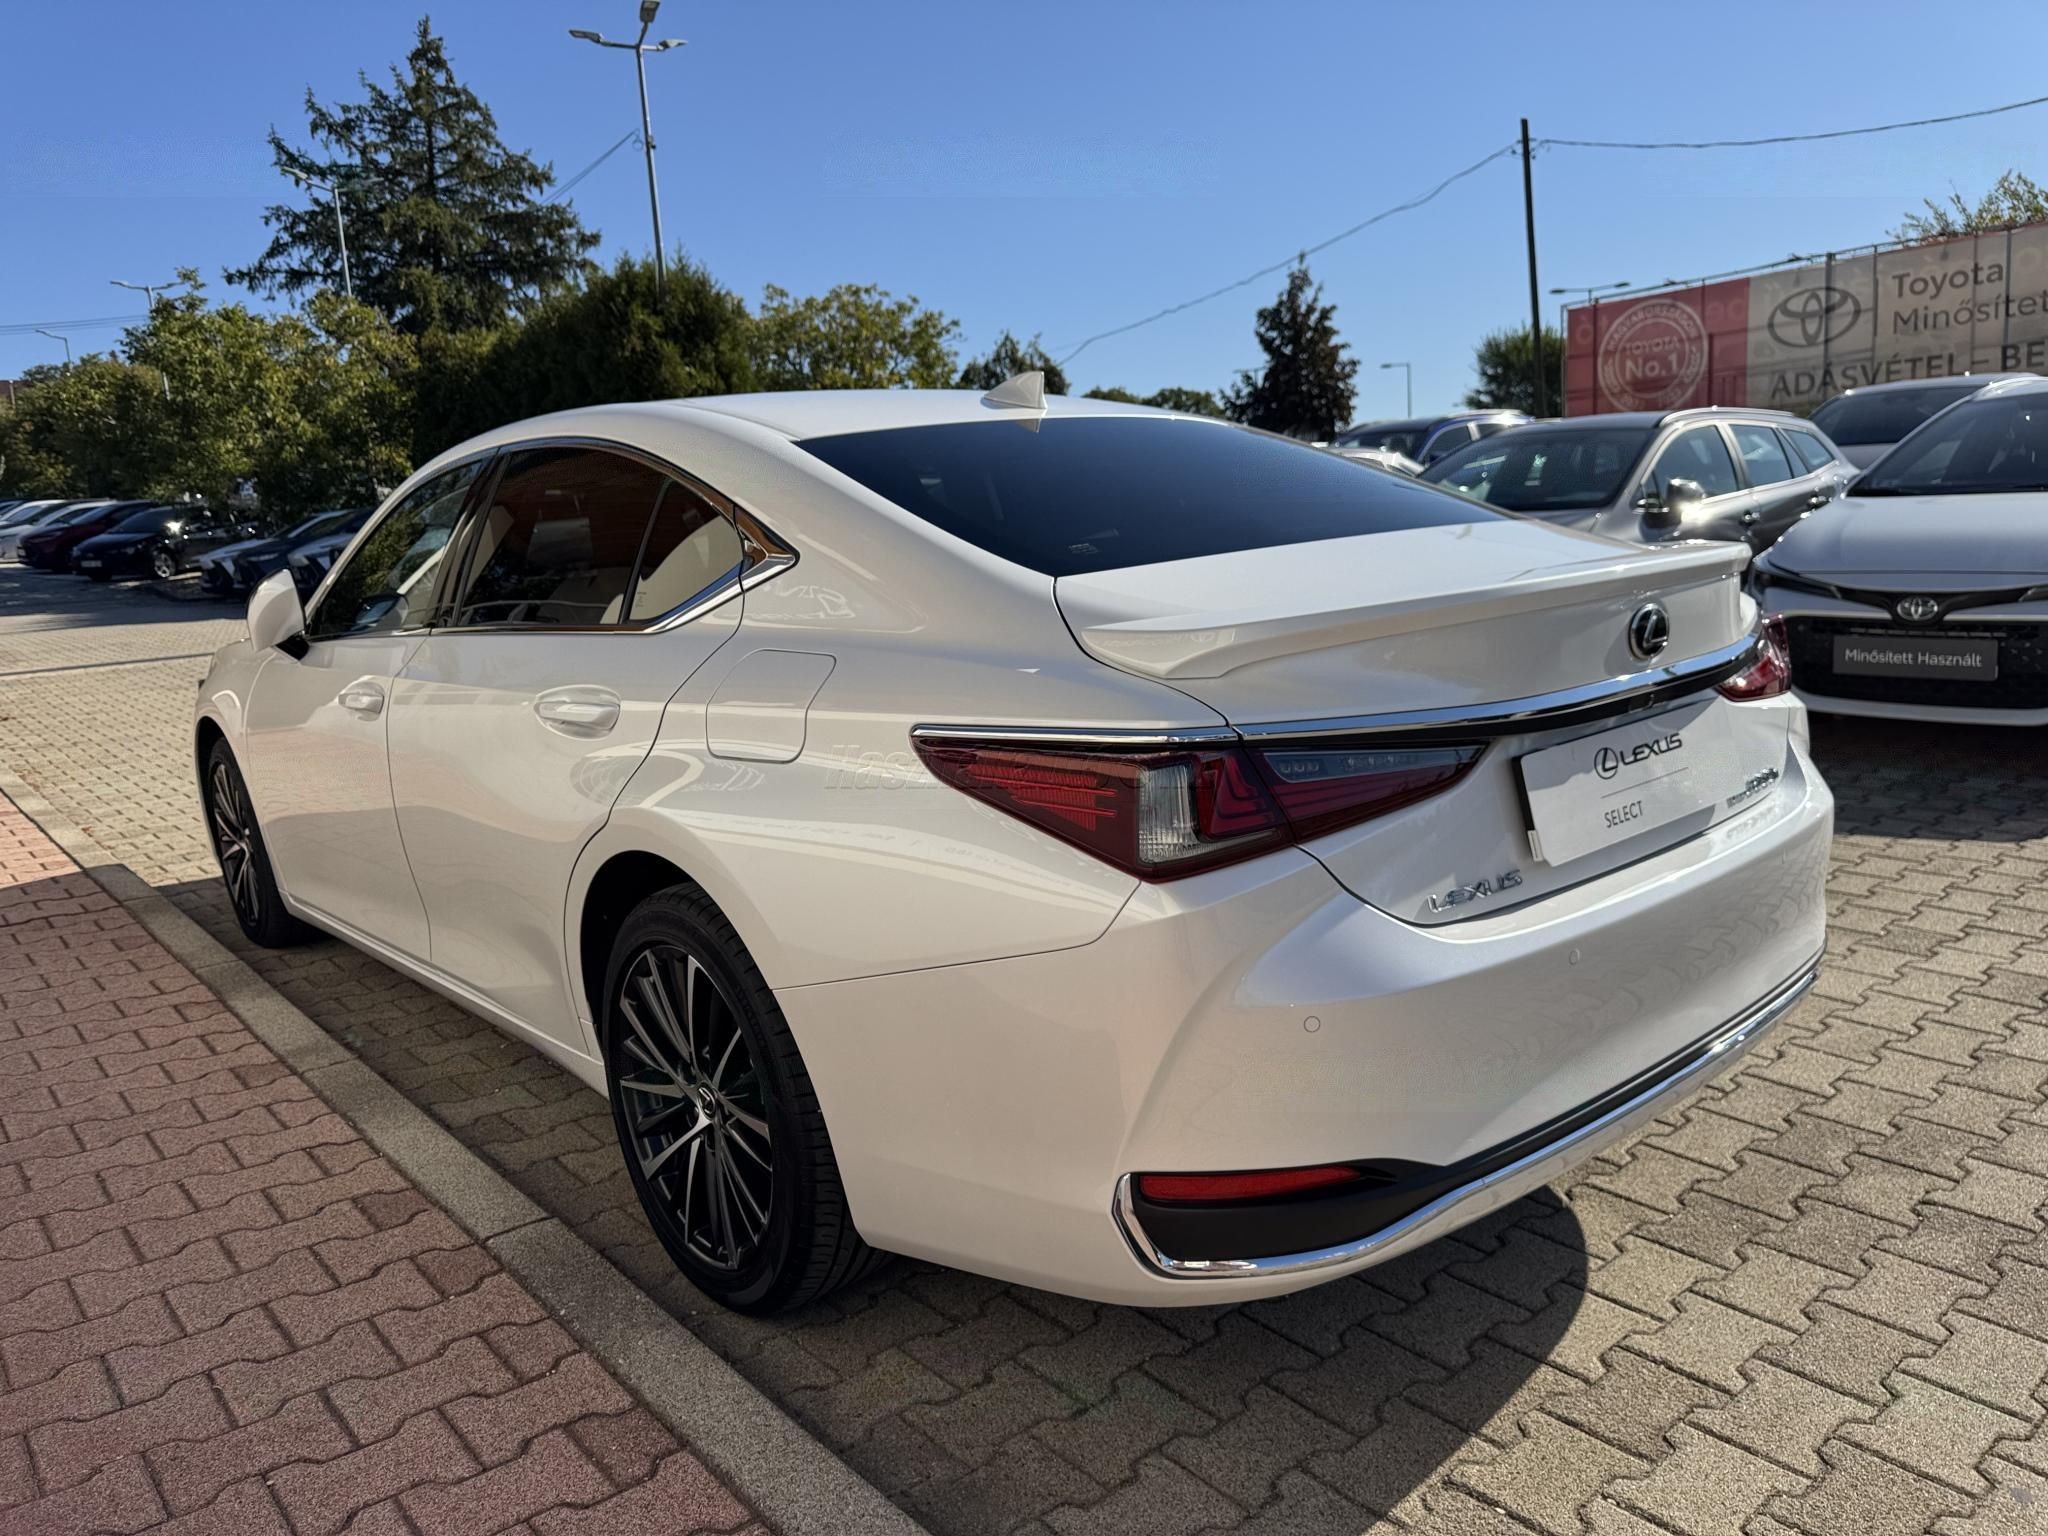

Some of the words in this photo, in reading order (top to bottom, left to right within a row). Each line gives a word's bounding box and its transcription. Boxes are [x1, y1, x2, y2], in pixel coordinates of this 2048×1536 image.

[1892, 261, 2004, 300] Toyota
[1625, 335, 1681, 354] TOYOTA
[1625, 352, 1679, 381] No.1
[1771, 352, 1961, 399] ADÁSVÉTEL
[1844, 648, 1914, 665] Minősített
[1917, 652, 1982, 668] Használt
[1619, 732, 1683, 767] LEXUS
[1604, 800, 1644, 829] SELECT
[1427, 868, 1523, 914] LEXUS
